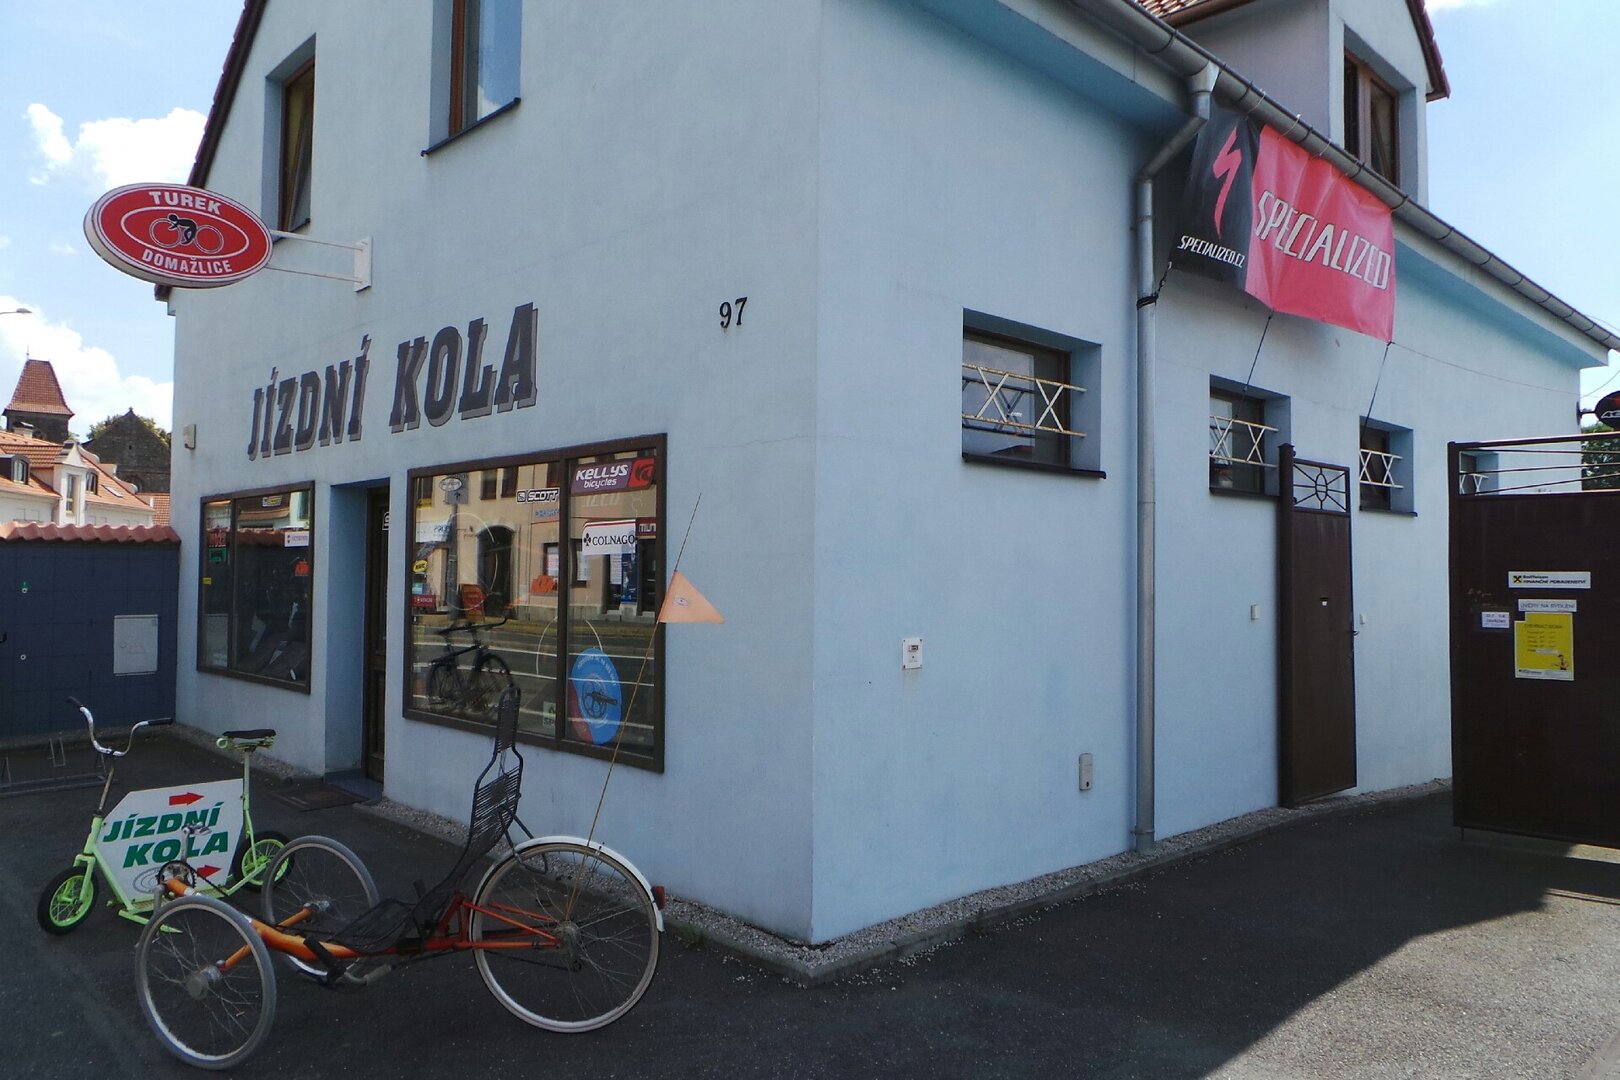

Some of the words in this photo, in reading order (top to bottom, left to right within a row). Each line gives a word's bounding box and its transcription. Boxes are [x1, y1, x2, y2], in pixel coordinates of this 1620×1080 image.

[148, 191, 222, 215] TUREK
[1177, 235, 1246, 269] SPECIALIZED.CZ
[1255, 190, 1392, 291] SPECIALIZED
[141, 247, 233, 274] DOMAŽLICE
[720, 297, 748, 328] 97
[247, 334, 372, 461] JÍZDNÍ
[389, 302, 539, 433] KOLA
[575, 464, 629, 482] KELLYS
[583, 477, 618, 490] bicycles
[526, 488, 559, 502] SCOTT
[592, 534, 636, 547] COLNAGO
[103, 801, 224, 842] JÍZDNÍ
[122, 831, 229, 869] KOLA
